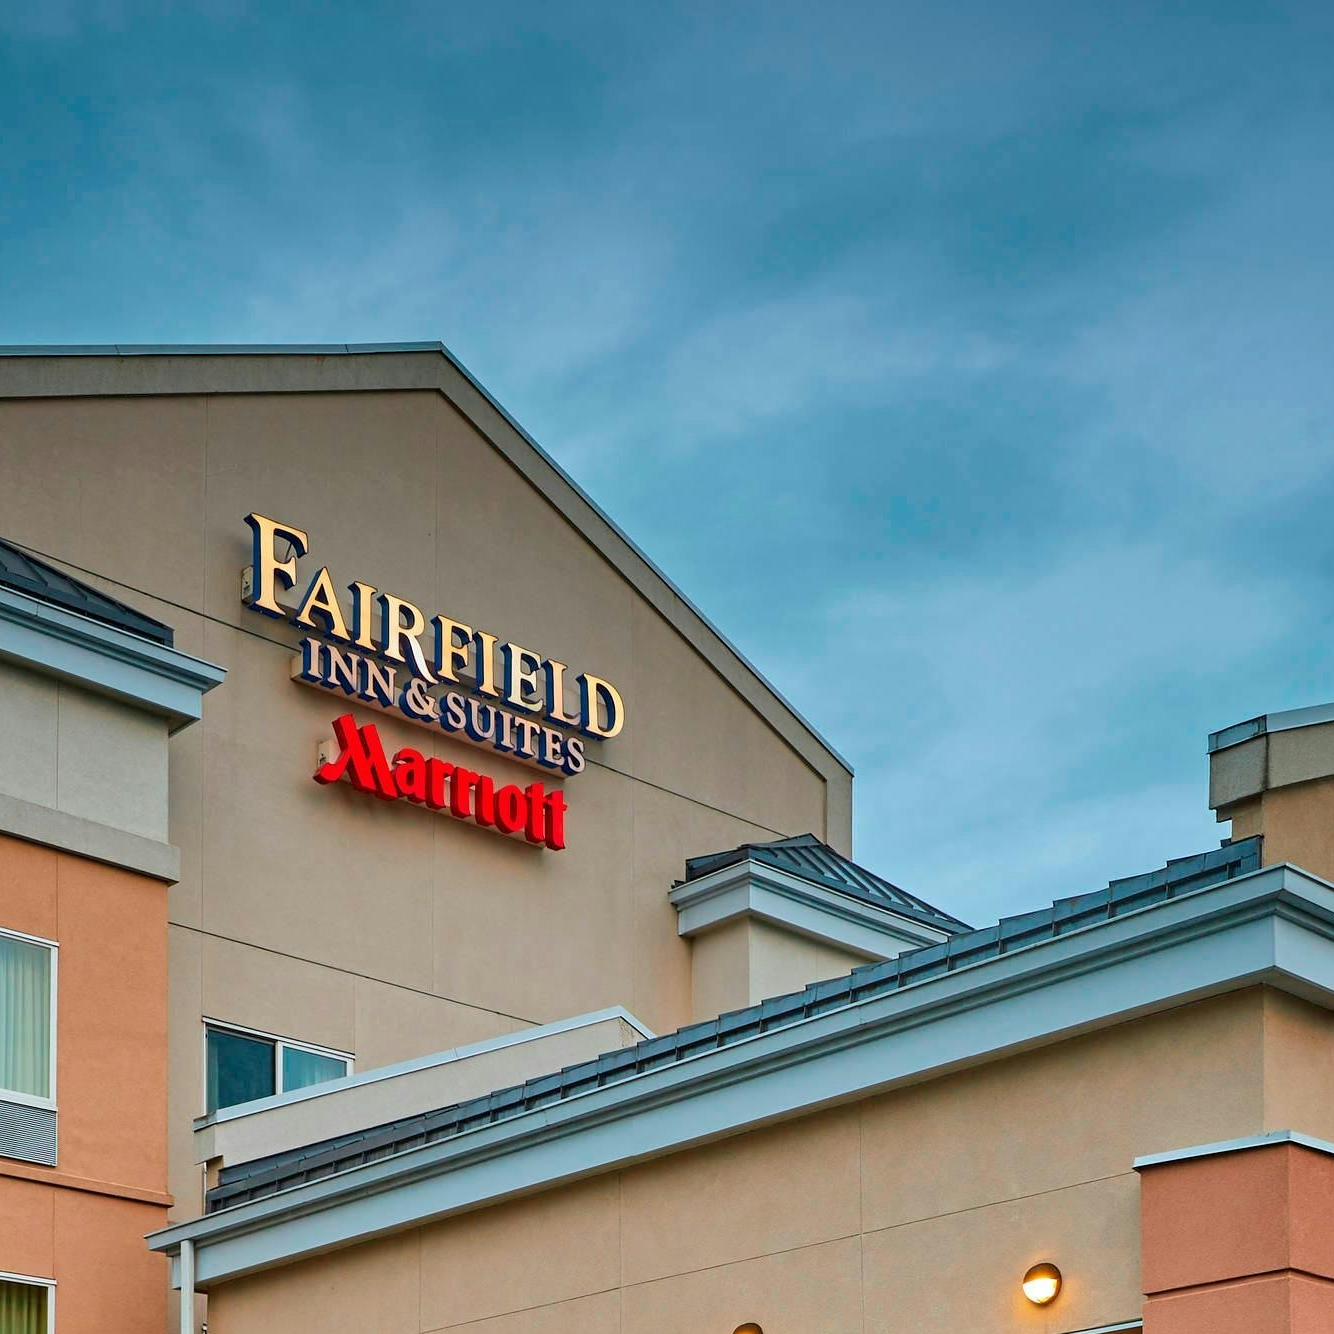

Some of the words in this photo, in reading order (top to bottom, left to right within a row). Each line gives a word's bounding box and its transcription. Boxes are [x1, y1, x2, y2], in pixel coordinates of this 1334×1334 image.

[244, 512, 625, 739] FAIRFIELD
[300, 637, 399, 707] INN
[404, 678, 442, 721] &
[442, 691, 587, 775] SUITES
[313, 713, 568, 851] Marriott
